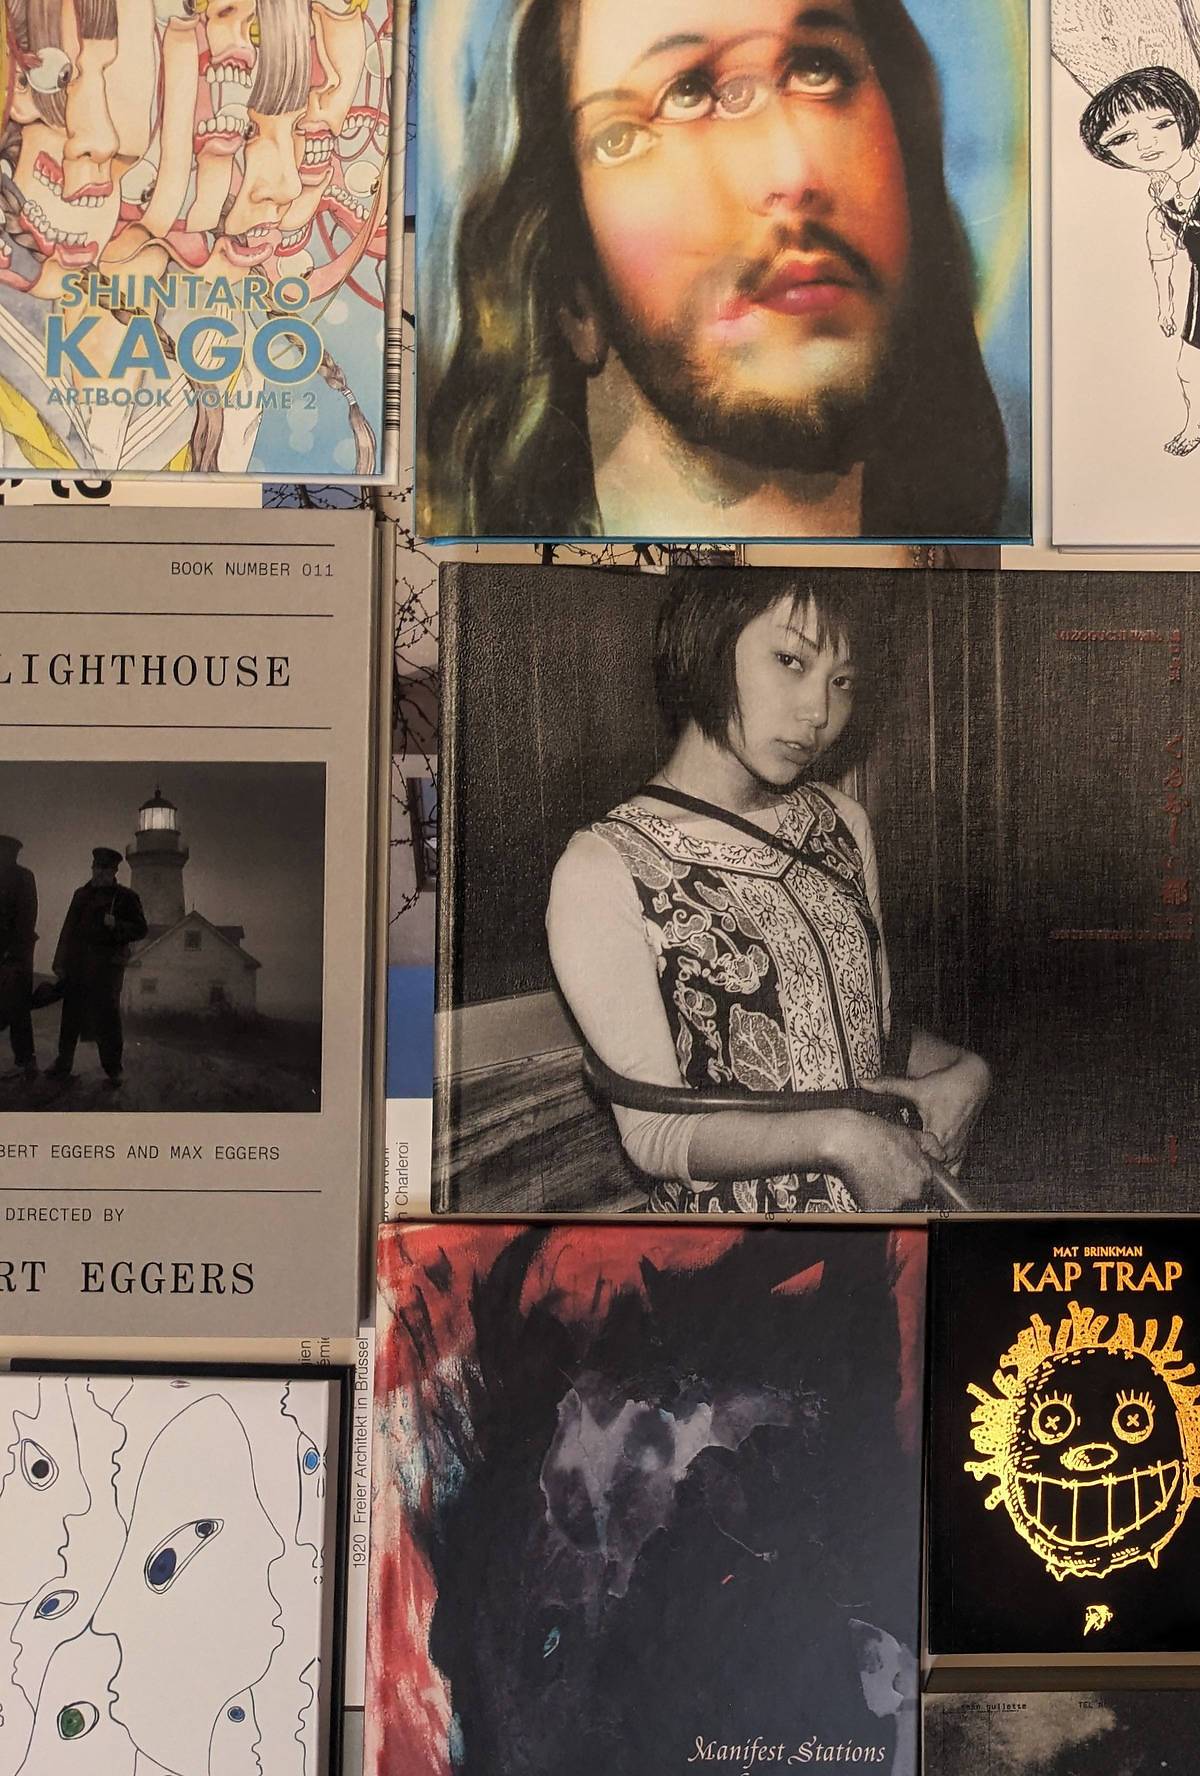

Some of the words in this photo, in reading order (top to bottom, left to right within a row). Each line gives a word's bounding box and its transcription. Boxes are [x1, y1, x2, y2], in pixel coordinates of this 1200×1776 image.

[60, 273, 312, 312] SHINTARO
[46, 315, 324, 385] KAGO
[47, 387, 172, 408] ARTBOOK
[183, 389, 293, 410] VOLUME
[302, 390, 318, 410] 2
[170, 561, 214, 577] BOOK
[225, 562, 291, 577] NUMBER
[302, 563, 334, 578] 011
[51, 1145, 116, 1160] EGGERS
[127, 1145, 159, 1160] AND
[170, 1145, 203, 1160] MAX
[215, 1146, 281, 1161] EGGERS
[394, 1141, 409, 1206] Charleroi
[5, 1207, 92, 1222] DIRECTED
[104, 1208, 125, 1222] BY
[1053, 1246, 1079, 1258] MAT
[1084, 1246, 1143, 1257] BRINKMAN
[80, 1261, 256, 1295] EGGERS
[1012, 1262, 1082, 1293] KAP
[1092, 1261, 1183, 1292] TRAP
[355, 1337, 369, 1391] Brüssel
[356, 1398, 368, 1409] in
[354, 1416, 368, 1479] Architekt
[354, 1483, 368, 1524] Freier
[352, 1534, 368, 1569] 1920
[687, 1735, 786, 1770] Manifest
[787, 1735, 886, 1765] Stations
